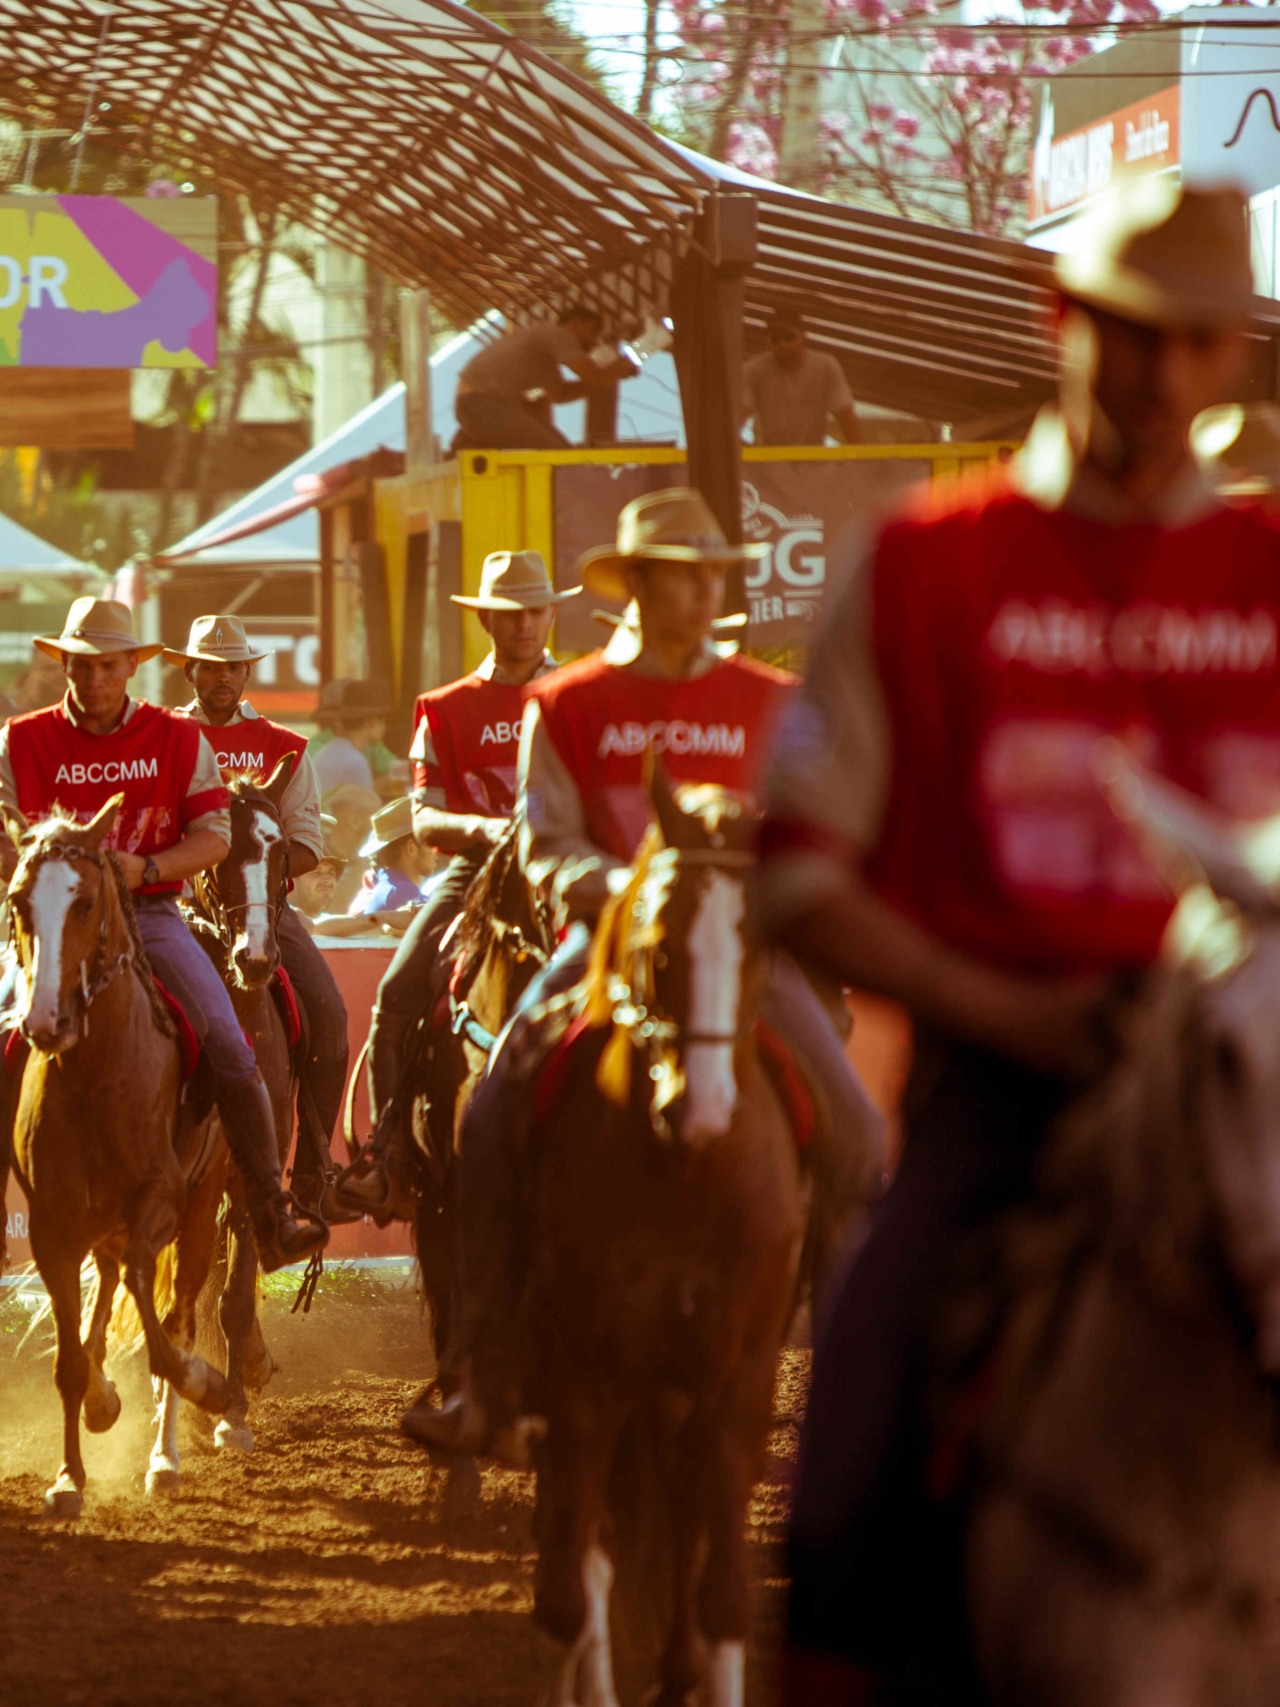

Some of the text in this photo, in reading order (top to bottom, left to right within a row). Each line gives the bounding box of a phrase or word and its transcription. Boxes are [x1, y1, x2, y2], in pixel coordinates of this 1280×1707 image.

[748, 596, 784, 625] IER
[598, 720, 746, 759] ABCCMM
[54, 757, 158, 785] ABCCMM
[215, 751, 264, 769] CMM
